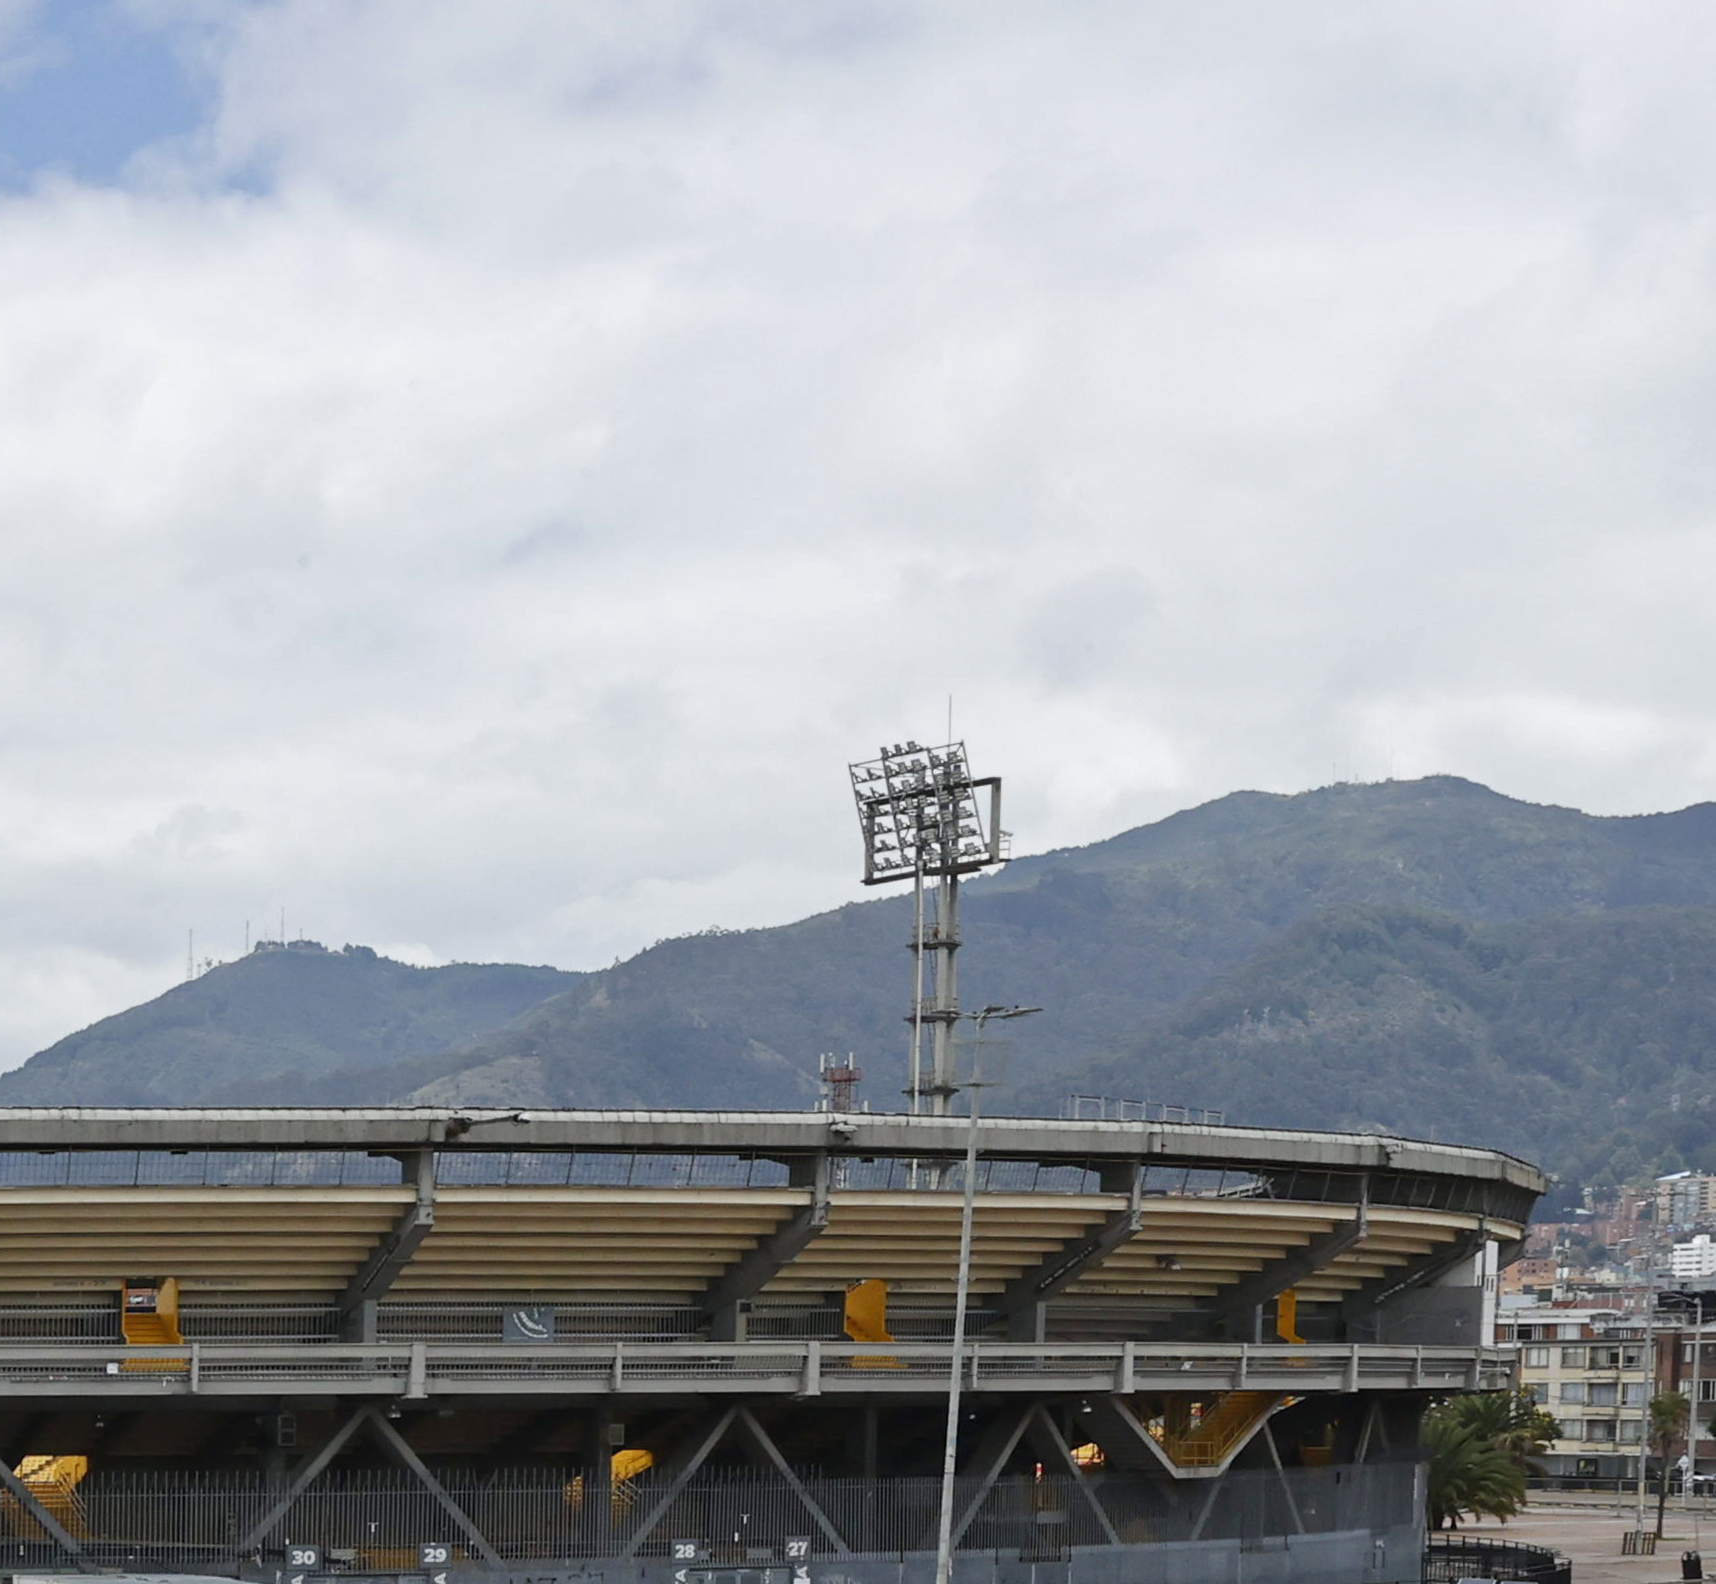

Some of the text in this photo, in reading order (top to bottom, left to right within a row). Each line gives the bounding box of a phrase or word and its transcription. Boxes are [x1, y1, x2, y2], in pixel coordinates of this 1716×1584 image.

[424, 1549, 447, 1563] 29
[675, 1544, 695, 1559] 28
[788, 1541, 807, 1556] 27
[292, 1550, 316, 1565] 30
